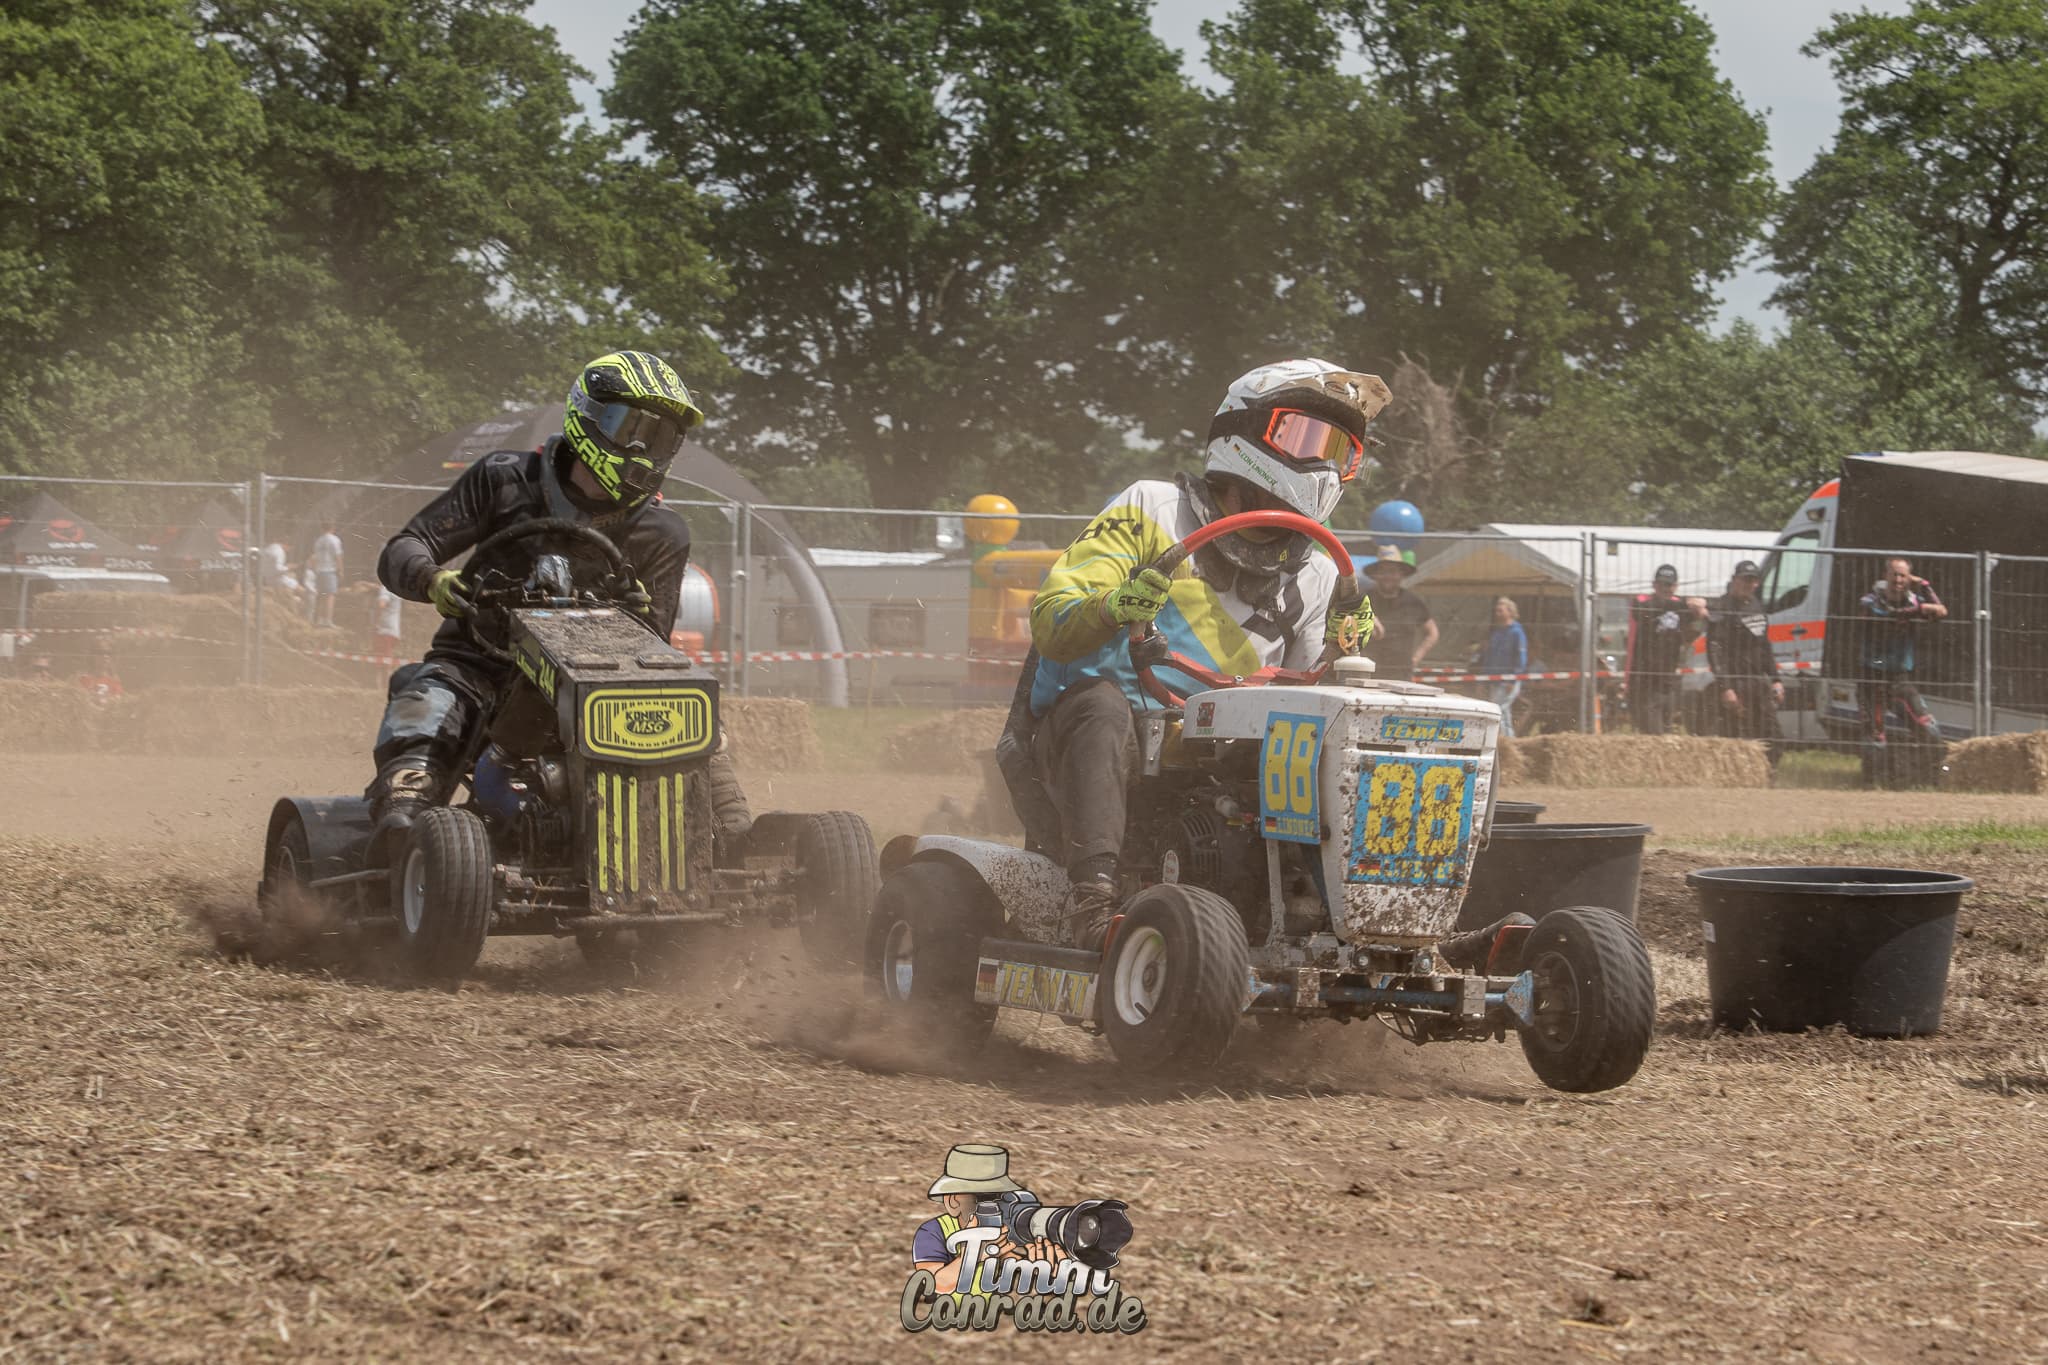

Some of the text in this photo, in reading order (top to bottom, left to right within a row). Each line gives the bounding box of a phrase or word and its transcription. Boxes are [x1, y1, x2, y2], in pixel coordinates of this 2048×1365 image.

[625, 710, 672, 722] KONERT
[631, 720, 666, 733] MSG
[1265, 719, 1317, 815] 88
[1365, 763, 1467, 856] 88
